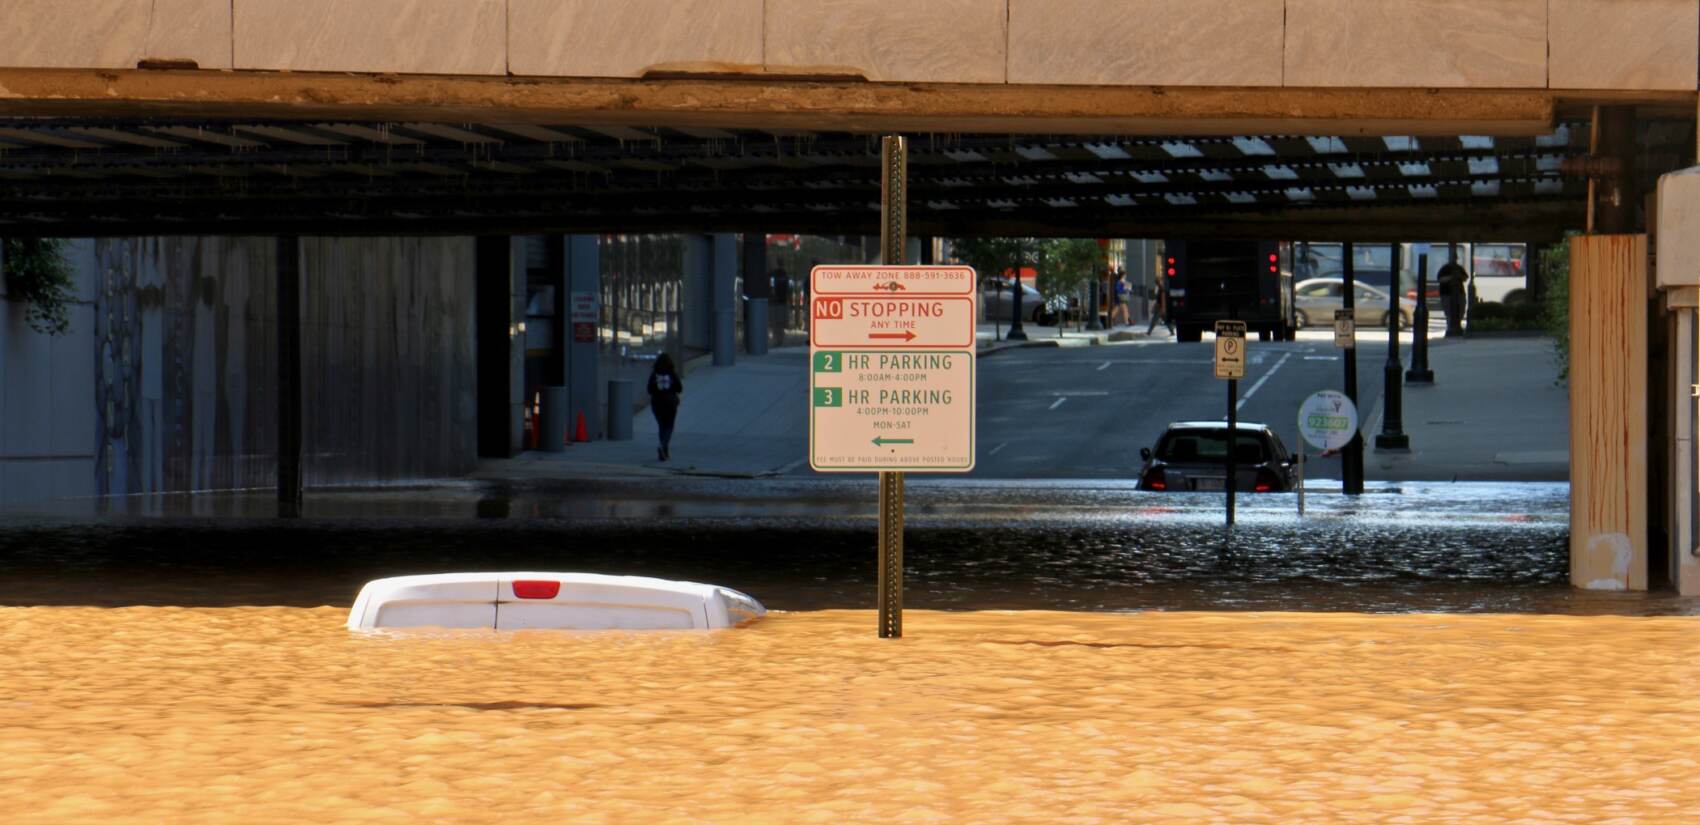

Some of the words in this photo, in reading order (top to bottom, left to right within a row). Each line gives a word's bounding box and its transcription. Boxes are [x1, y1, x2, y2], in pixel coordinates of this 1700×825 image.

[816, 301, 841, 317] NO
[850, 302, 944, 317] STOPPING
[824, 355, 832, 370] 2
[849, 355, 870, 370] HR
[880, 355, 952, 370] PARKING
[858, 374, 926, 382] 8:00AM-4:00PM
[824, 390, 832, 404] 3
[849, 390, 870, 404] HR
[880, 390, 952, 404] PARKING
[873, 421, 911, 429] MON-SAT
